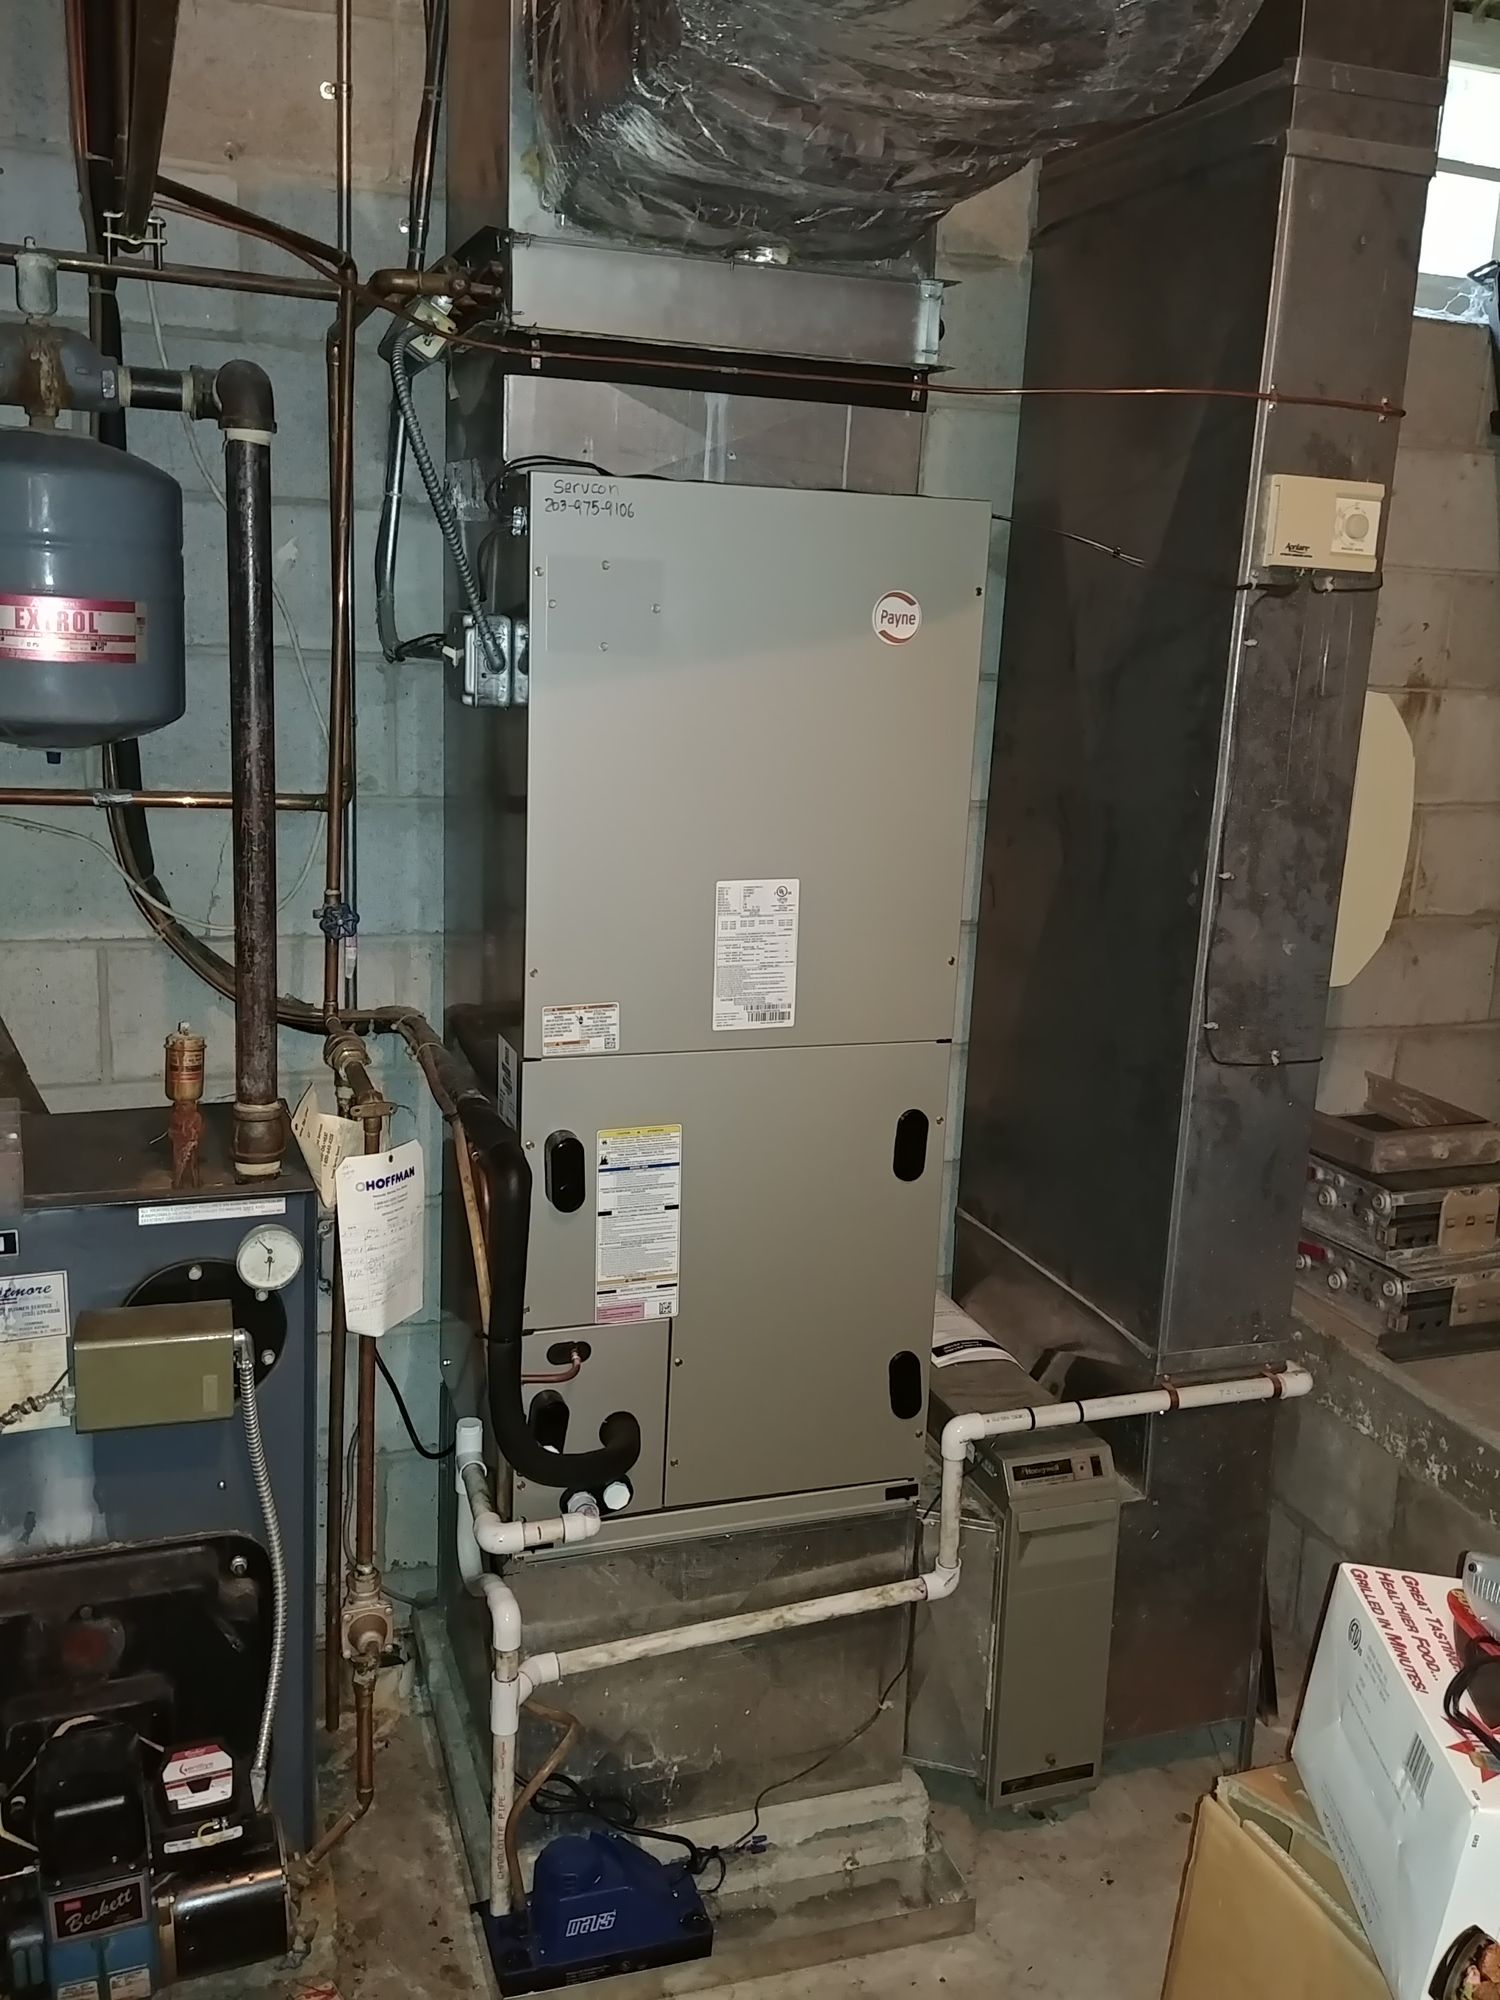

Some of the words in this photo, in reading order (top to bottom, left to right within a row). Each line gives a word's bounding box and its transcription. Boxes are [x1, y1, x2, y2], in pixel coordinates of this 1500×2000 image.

[552, 479, 620, 497] Servcon
[544, 497, 636, 519] 203-975-9106
[880, 609, 916, 627] Payne
[365, 1165, 416, 1192] HOFFMAN
[1350, 1568, 1384, 1621] GRILLED
[1402, 1574, 1433, 1615] GREAT
[1375, 1570, 1419, 1639] HEALTHIER
[1411, 1635, 1441, 1682] FOOD...
[1376, 1617, 1395, 1637] IN
[1385, 1632, 1430, 1695] MINUTES!
[497, 1794, 505, 1820] PIPE
[496, 1825, 505, 1880] CHARLOTTE
[65, 1888, 133, 1933] Beckett
